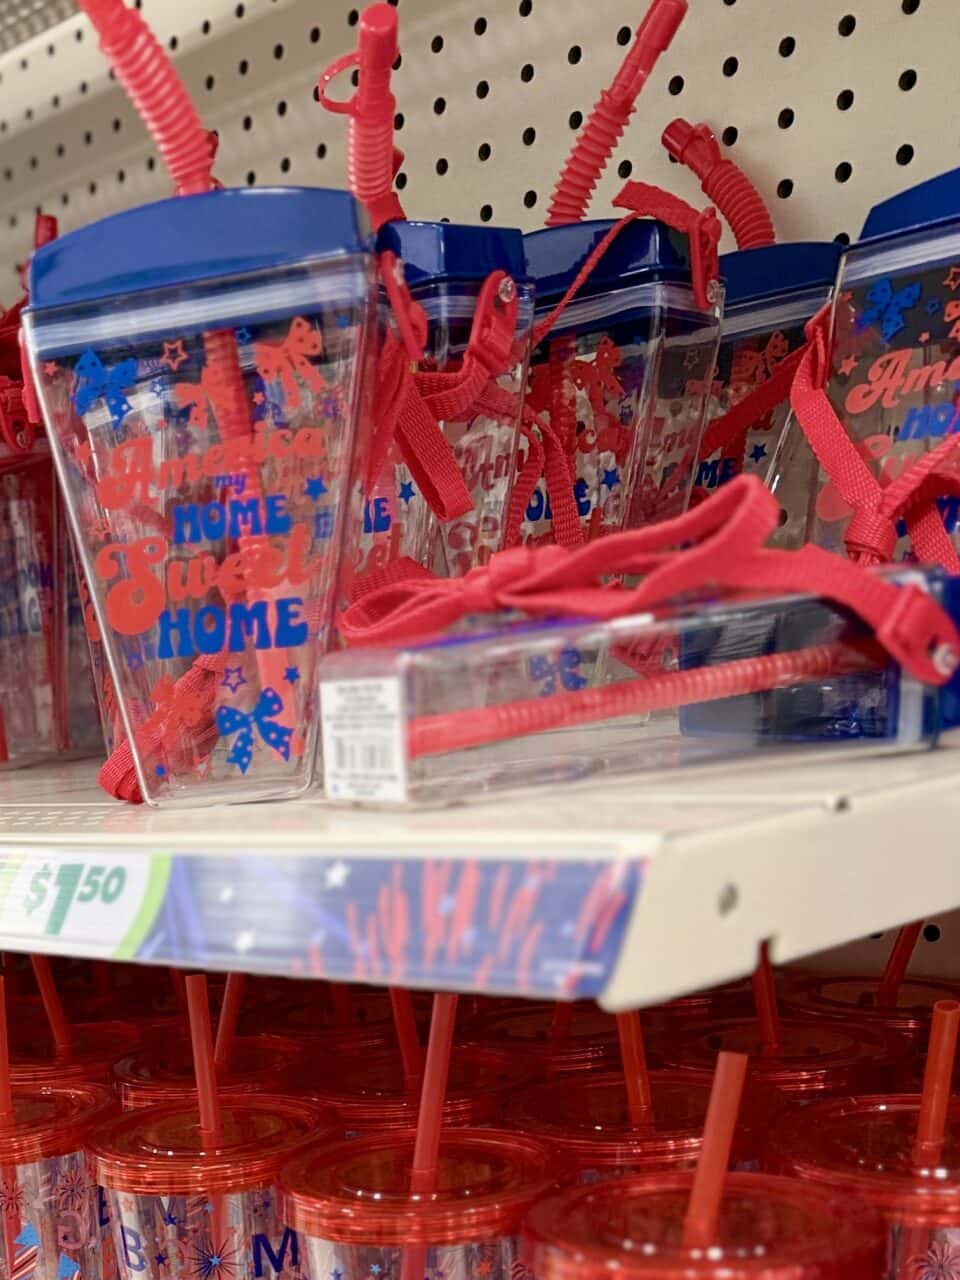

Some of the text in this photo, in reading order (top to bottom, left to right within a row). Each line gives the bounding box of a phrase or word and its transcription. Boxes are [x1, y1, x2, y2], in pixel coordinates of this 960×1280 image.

[96, 428, 327, 510] America
[215, 474, 248, 495] my
[172, 495, 292, 545] HOME
[96, 523, 327, 636] Sweet
[157, 597, 309, 660] HOME
